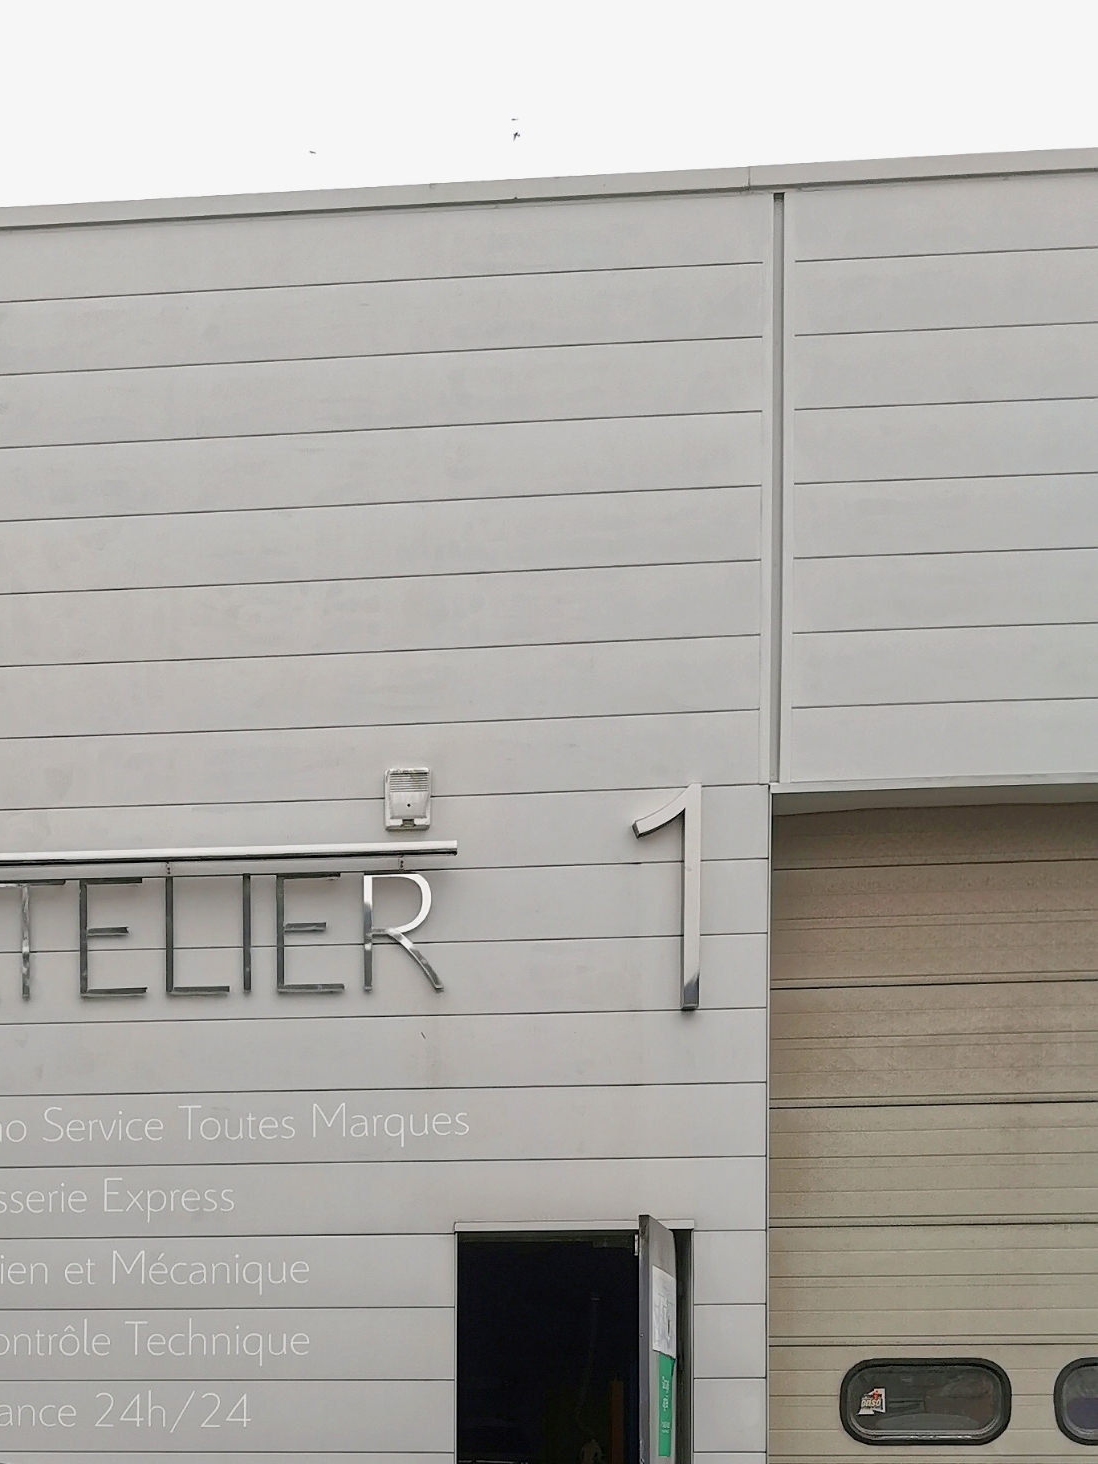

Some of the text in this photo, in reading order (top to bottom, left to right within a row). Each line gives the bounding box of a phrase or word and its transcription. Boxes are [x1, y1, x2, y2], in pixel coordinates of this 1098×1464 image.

[631, 782, 702, 1011] 1
[42, 1106, 164, 1142] Service
[178, 1104, 296, 1140] Toutes
[312, 1102, 470, 1148] Marques
[103, 1177, 235, 1223] Express
[63, 1256, 96, 1286] et
[111, 1249, 310, 1296] Mécanique
[124, 1317, 310, 1367] Technique
[94, 1390, 252, 1433] 24h/24
